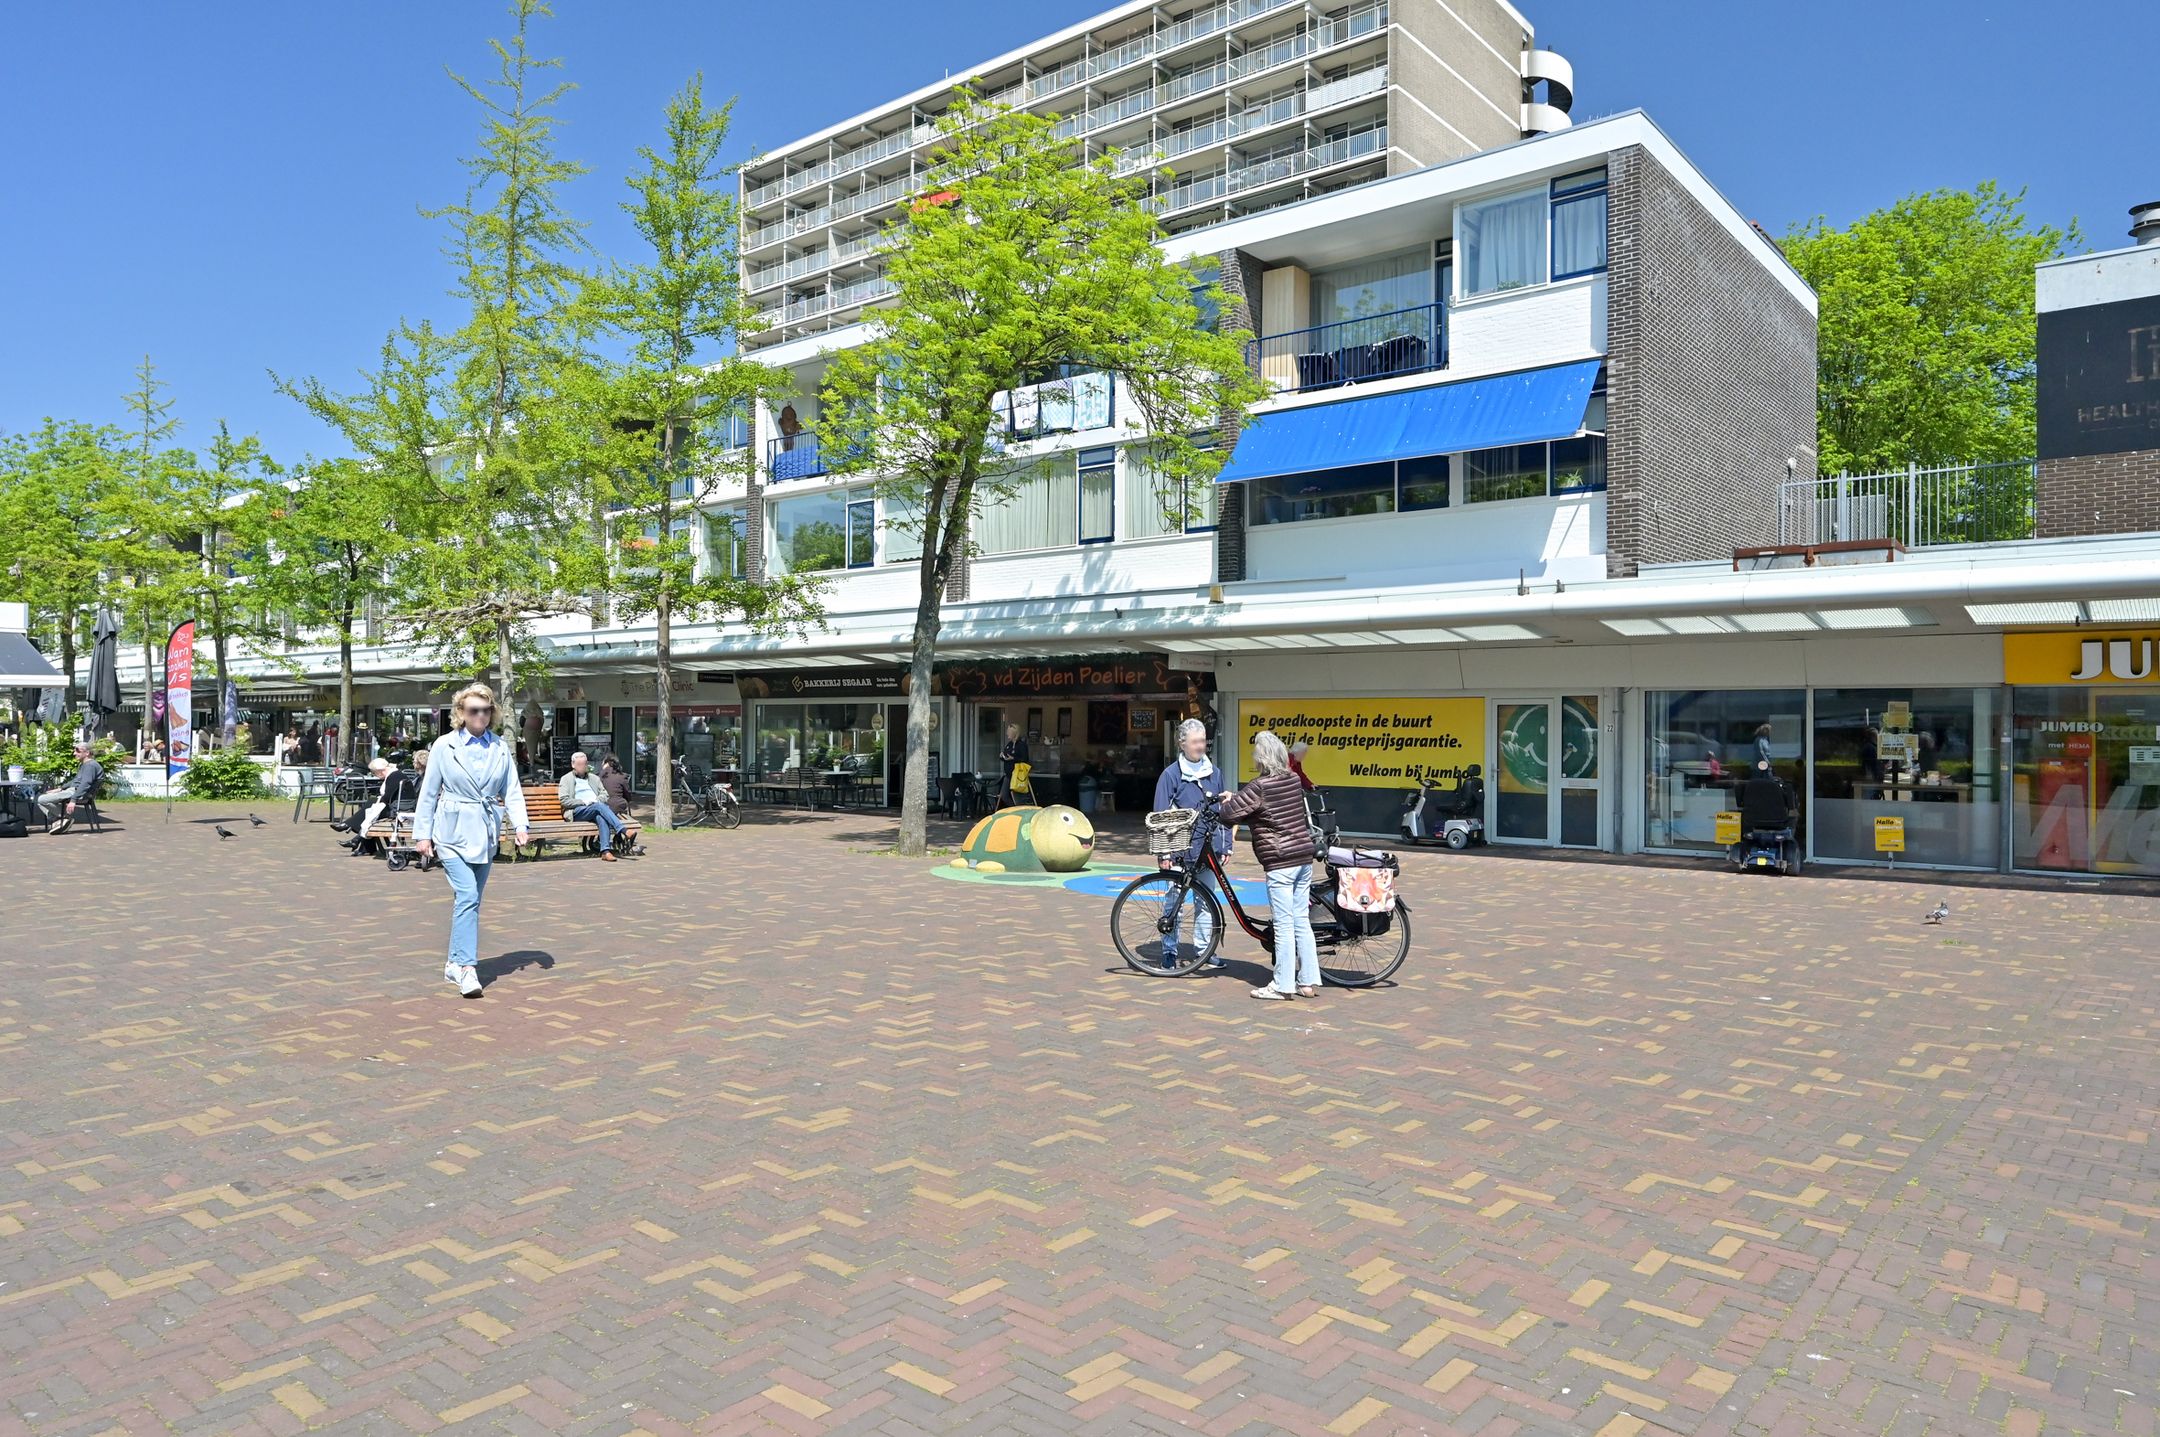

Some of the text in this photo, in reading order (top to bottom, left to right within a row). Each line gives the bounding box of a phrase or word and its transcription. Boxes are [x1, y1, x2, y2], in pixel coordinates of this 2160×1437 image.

[2070, 639, 2160, 680] JU
[803, 678, 873, 688] BAKKERIJ SEGAAR
[994, 667, 1147, 692] vd Zijden Poelier
[1249, 714, 1433, 731] De goedkoopste in de buurt
[2040, 721, 2104, 733] JUMBO
[1317, 733, 1463, 751] laagsteprijsgarantie.
[1350, 763, 1402, 778] Welkom
